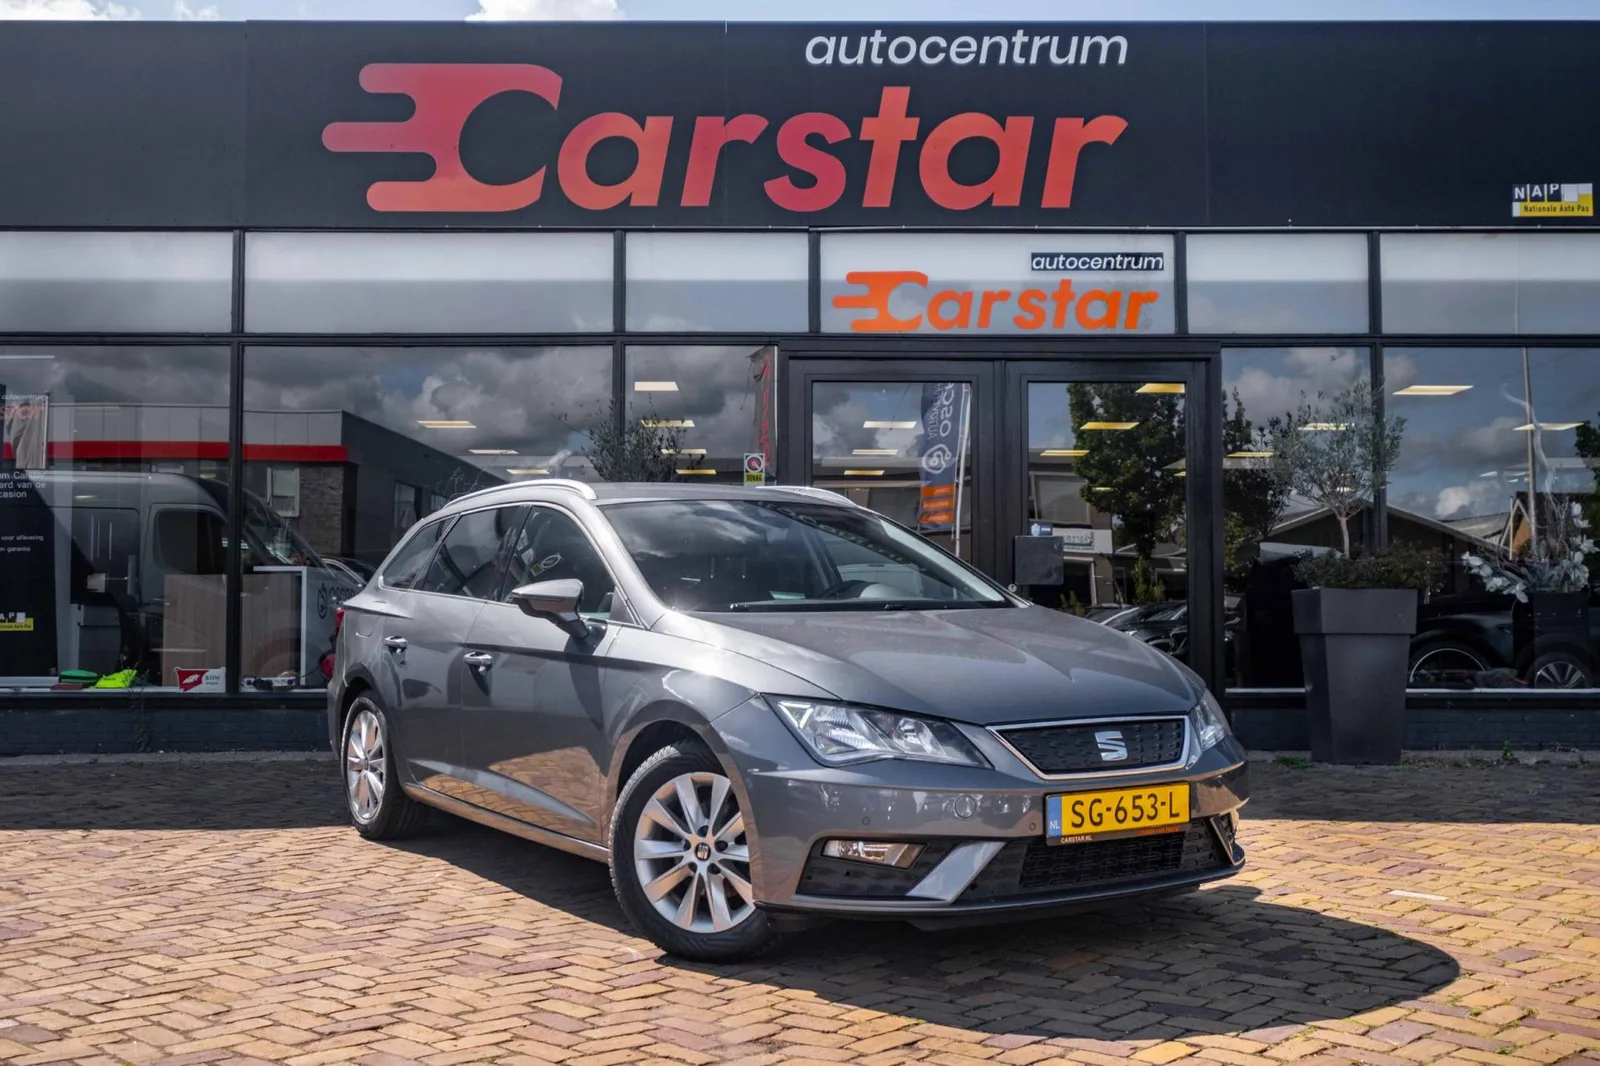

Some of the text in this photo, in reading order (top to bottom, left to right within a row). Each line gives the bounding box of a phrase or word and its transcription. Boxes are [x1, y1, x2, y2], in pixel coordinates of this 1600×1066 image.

[805, 29, 1128, 66] autocentrum
[322, 62, 1128, 212] Carstar
[1523, 204, 1590, 213] Nationale Auto Pas
[1032, 253, 1163, 270] autocentrum
[832, 271, 1160, 332] Carstar
[35, 481, 46, 489] de
[1071, 791, 1180, 828] SG-653-L
[1049, 820, 1061, 830] NL
[1060, 834, 1093, 844] CARSTAR.NL
